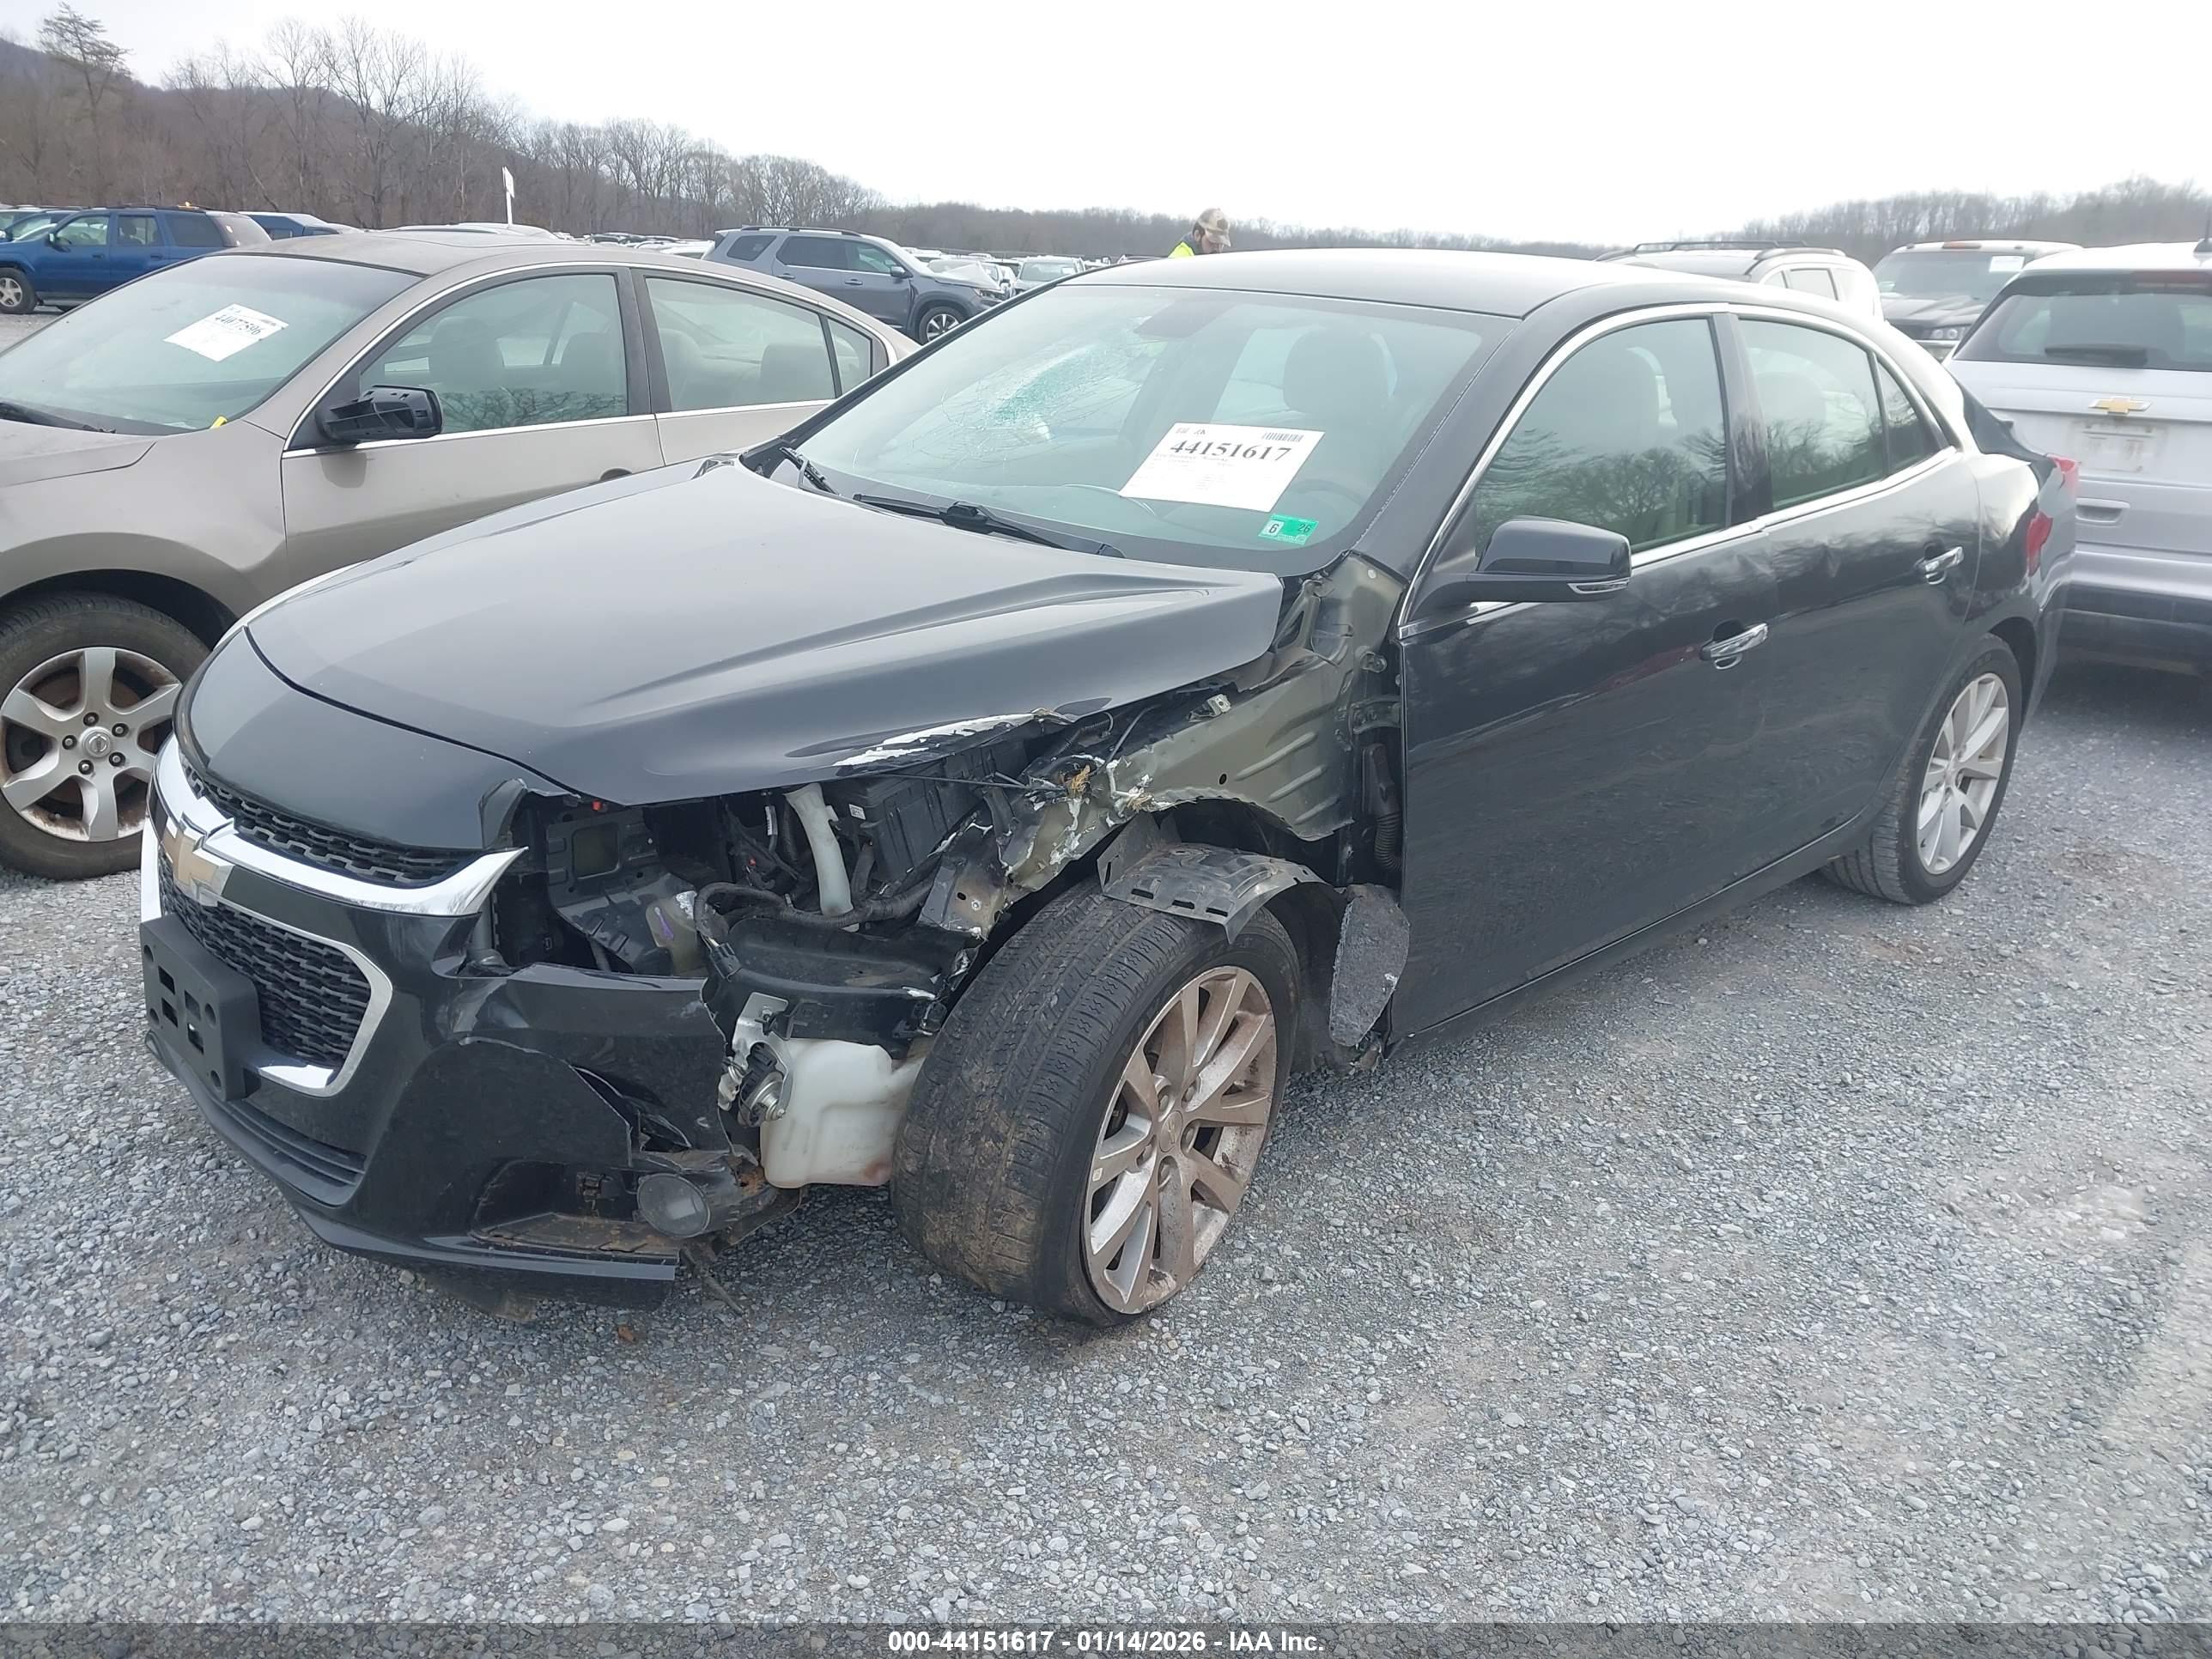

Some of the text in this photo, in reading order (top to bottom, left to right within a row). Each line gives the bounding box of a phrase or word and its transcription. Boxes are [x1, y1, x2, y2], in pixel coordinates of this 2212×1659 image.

[1170, 440, 1292, 461] 44151617
[1268, 523, 1312, 534] 6 26
